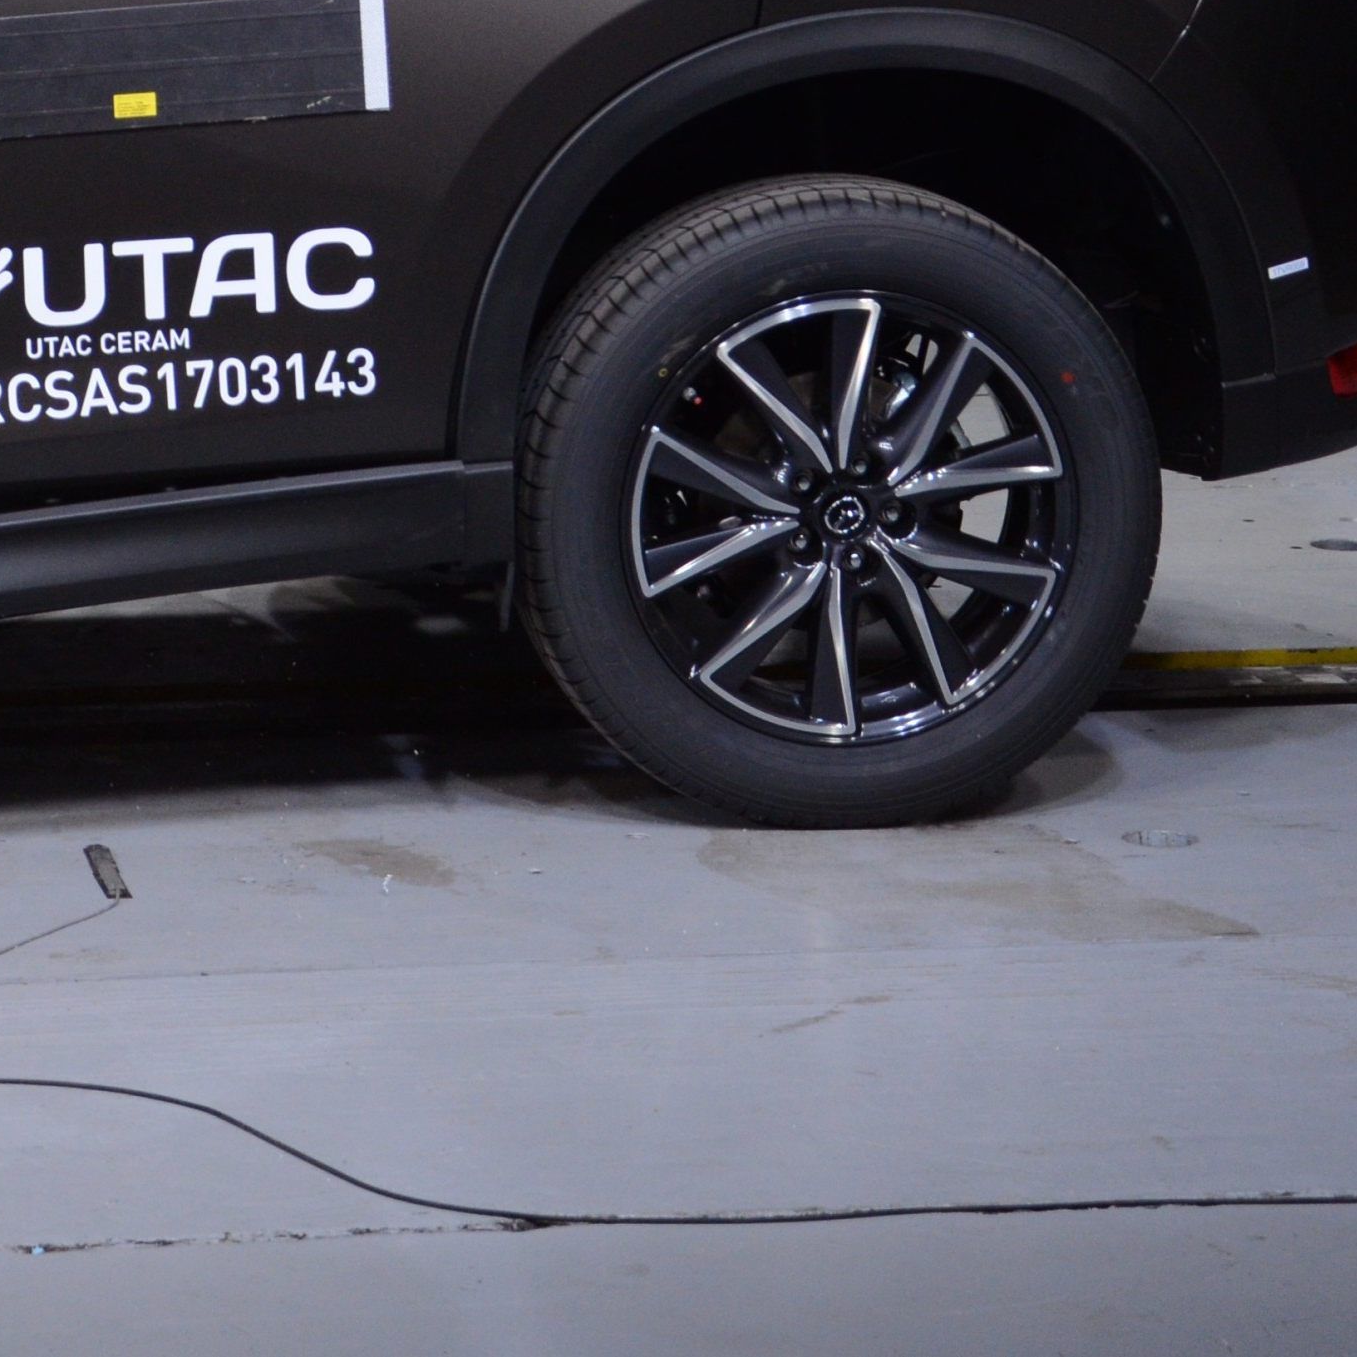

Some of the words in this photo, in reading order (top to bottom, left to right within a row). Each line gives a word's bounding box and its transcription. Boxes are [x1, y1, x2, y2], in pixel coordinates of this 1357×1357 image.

[22, 227, 376, 327] UTAC
[25, 334, 92, 359] UTAC
[100, 327, 190, 355] CERAM
